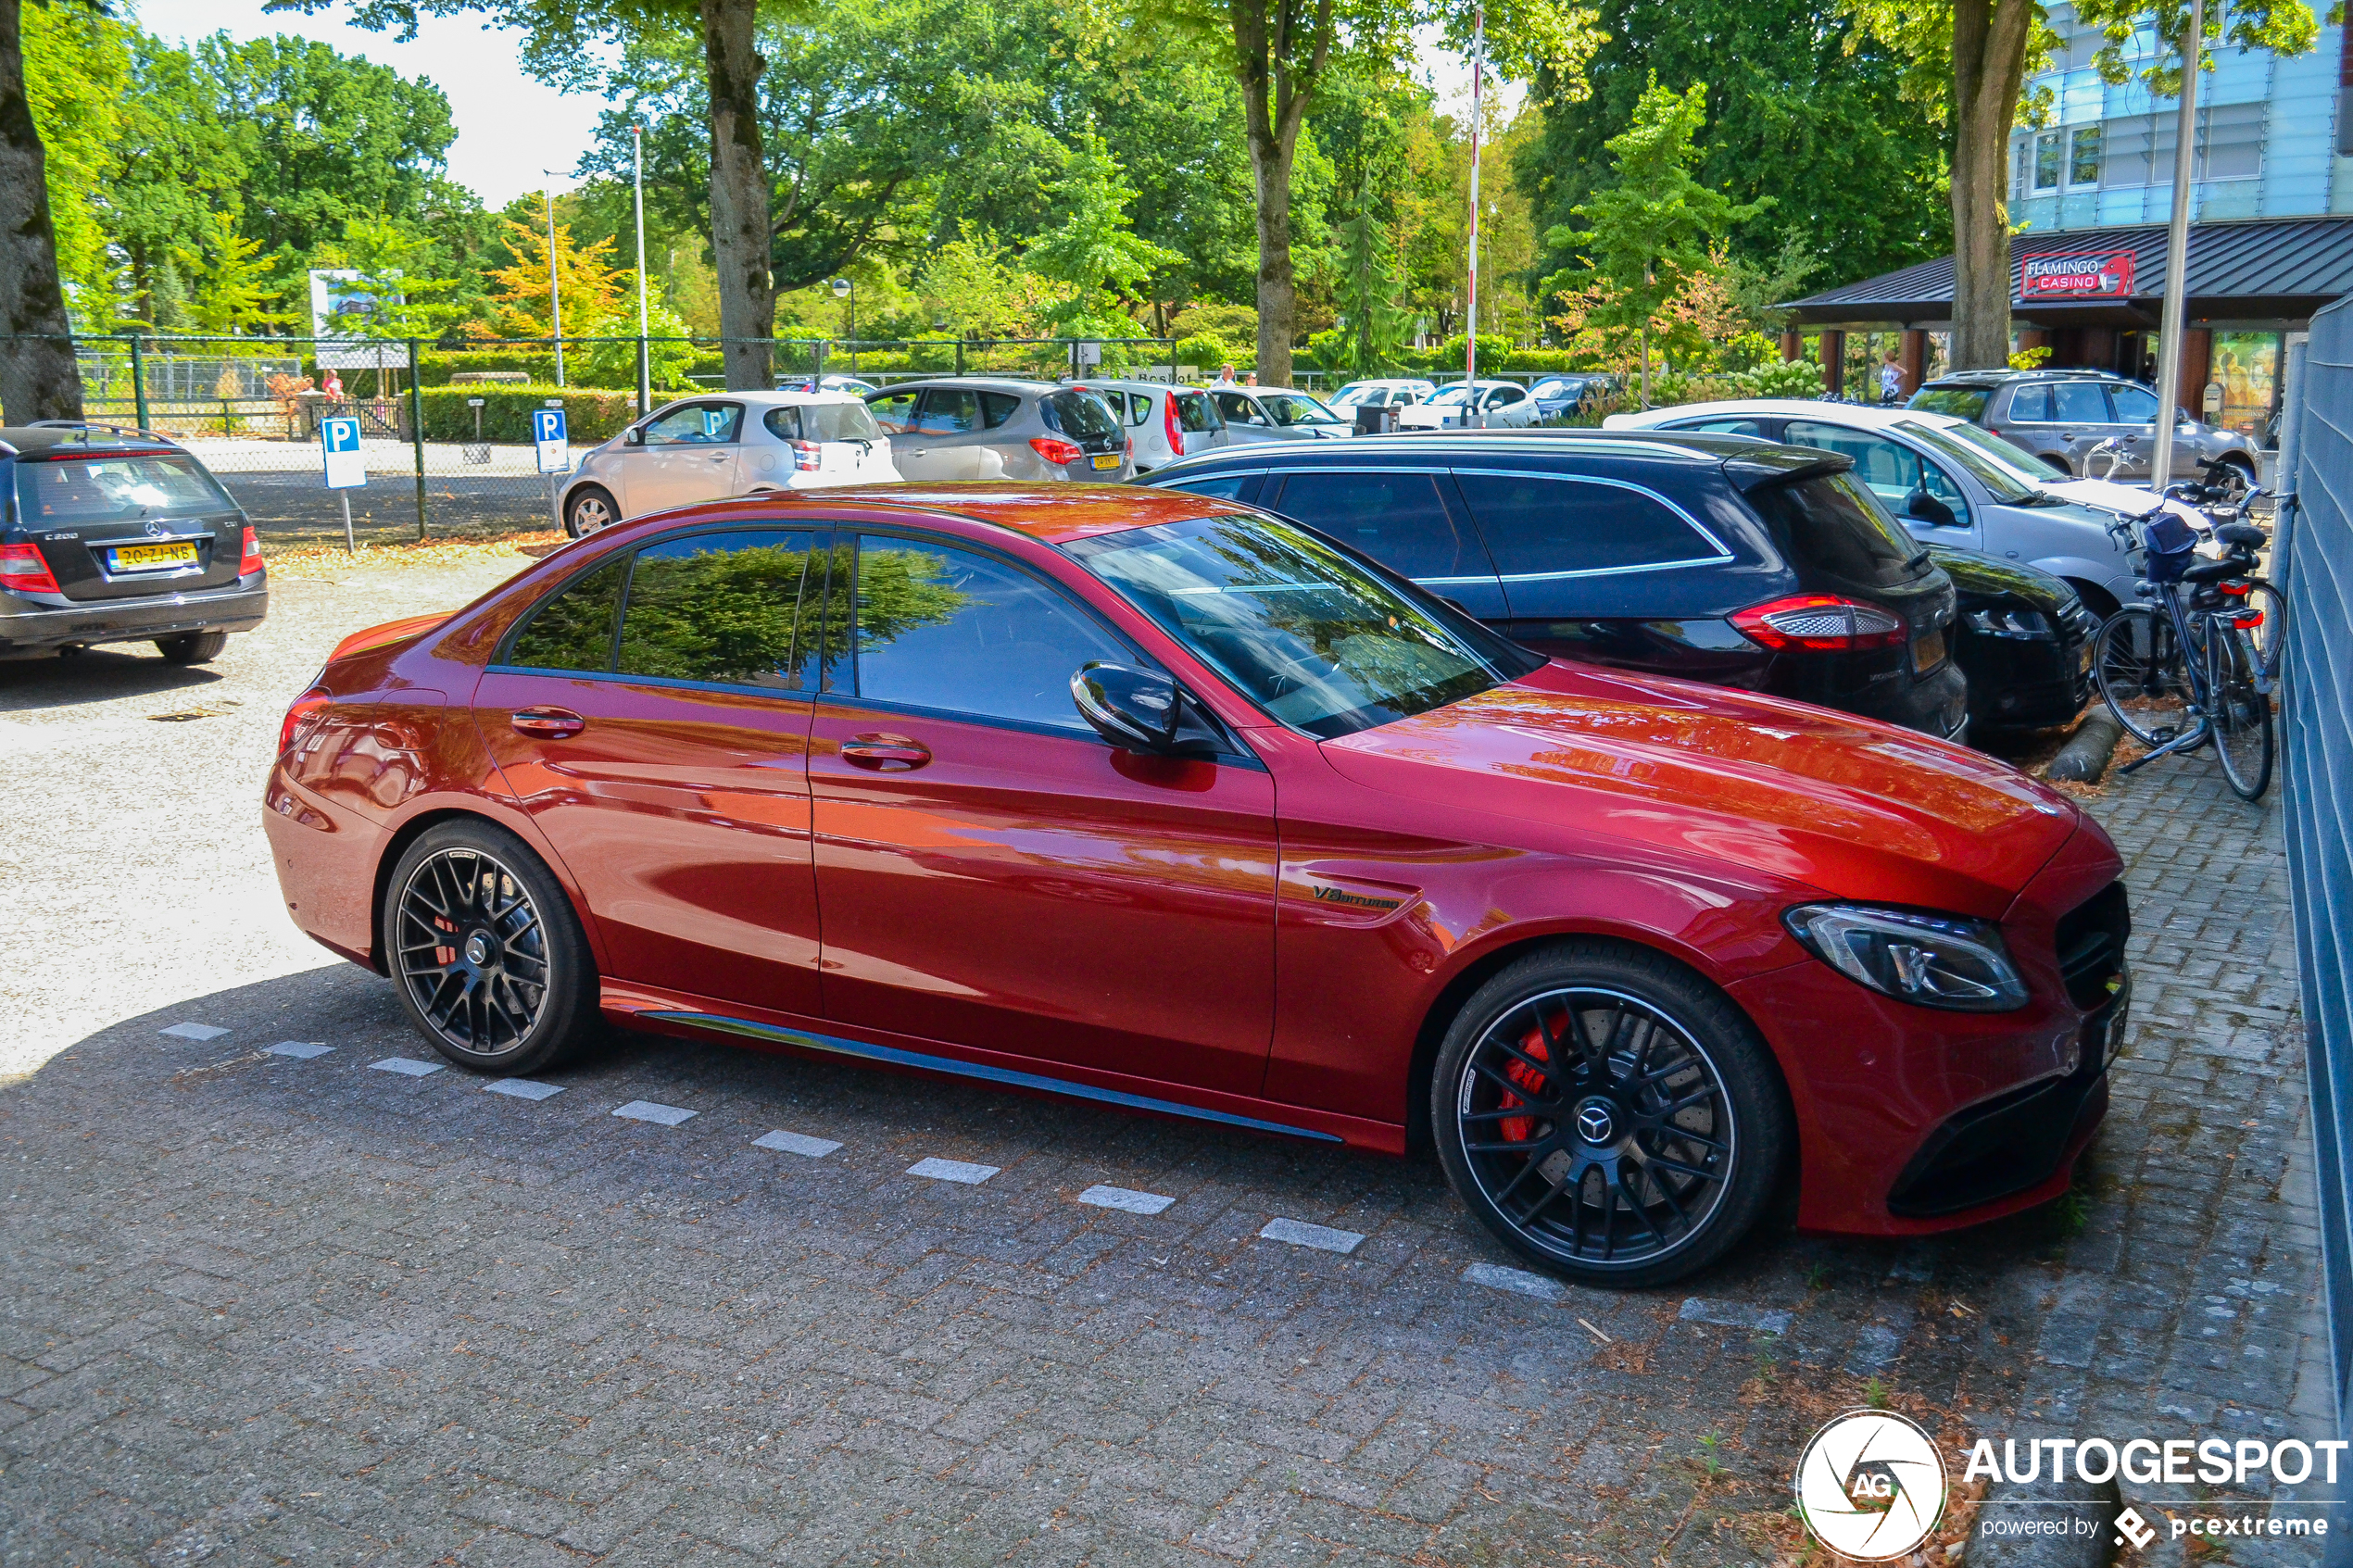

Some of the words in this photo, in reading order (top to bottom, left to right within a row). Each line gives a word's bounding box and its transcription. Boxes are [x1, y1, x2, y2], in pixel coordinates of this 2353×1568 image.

[2028, 260, 2098, 275] FLAMINGO
[2040, 276, 2095, 288] CASINO
[543, 413, 559, 440] P
[332, 421, 351, 452] P
[123, 546, 190, 564] 20-ZJ-NB
